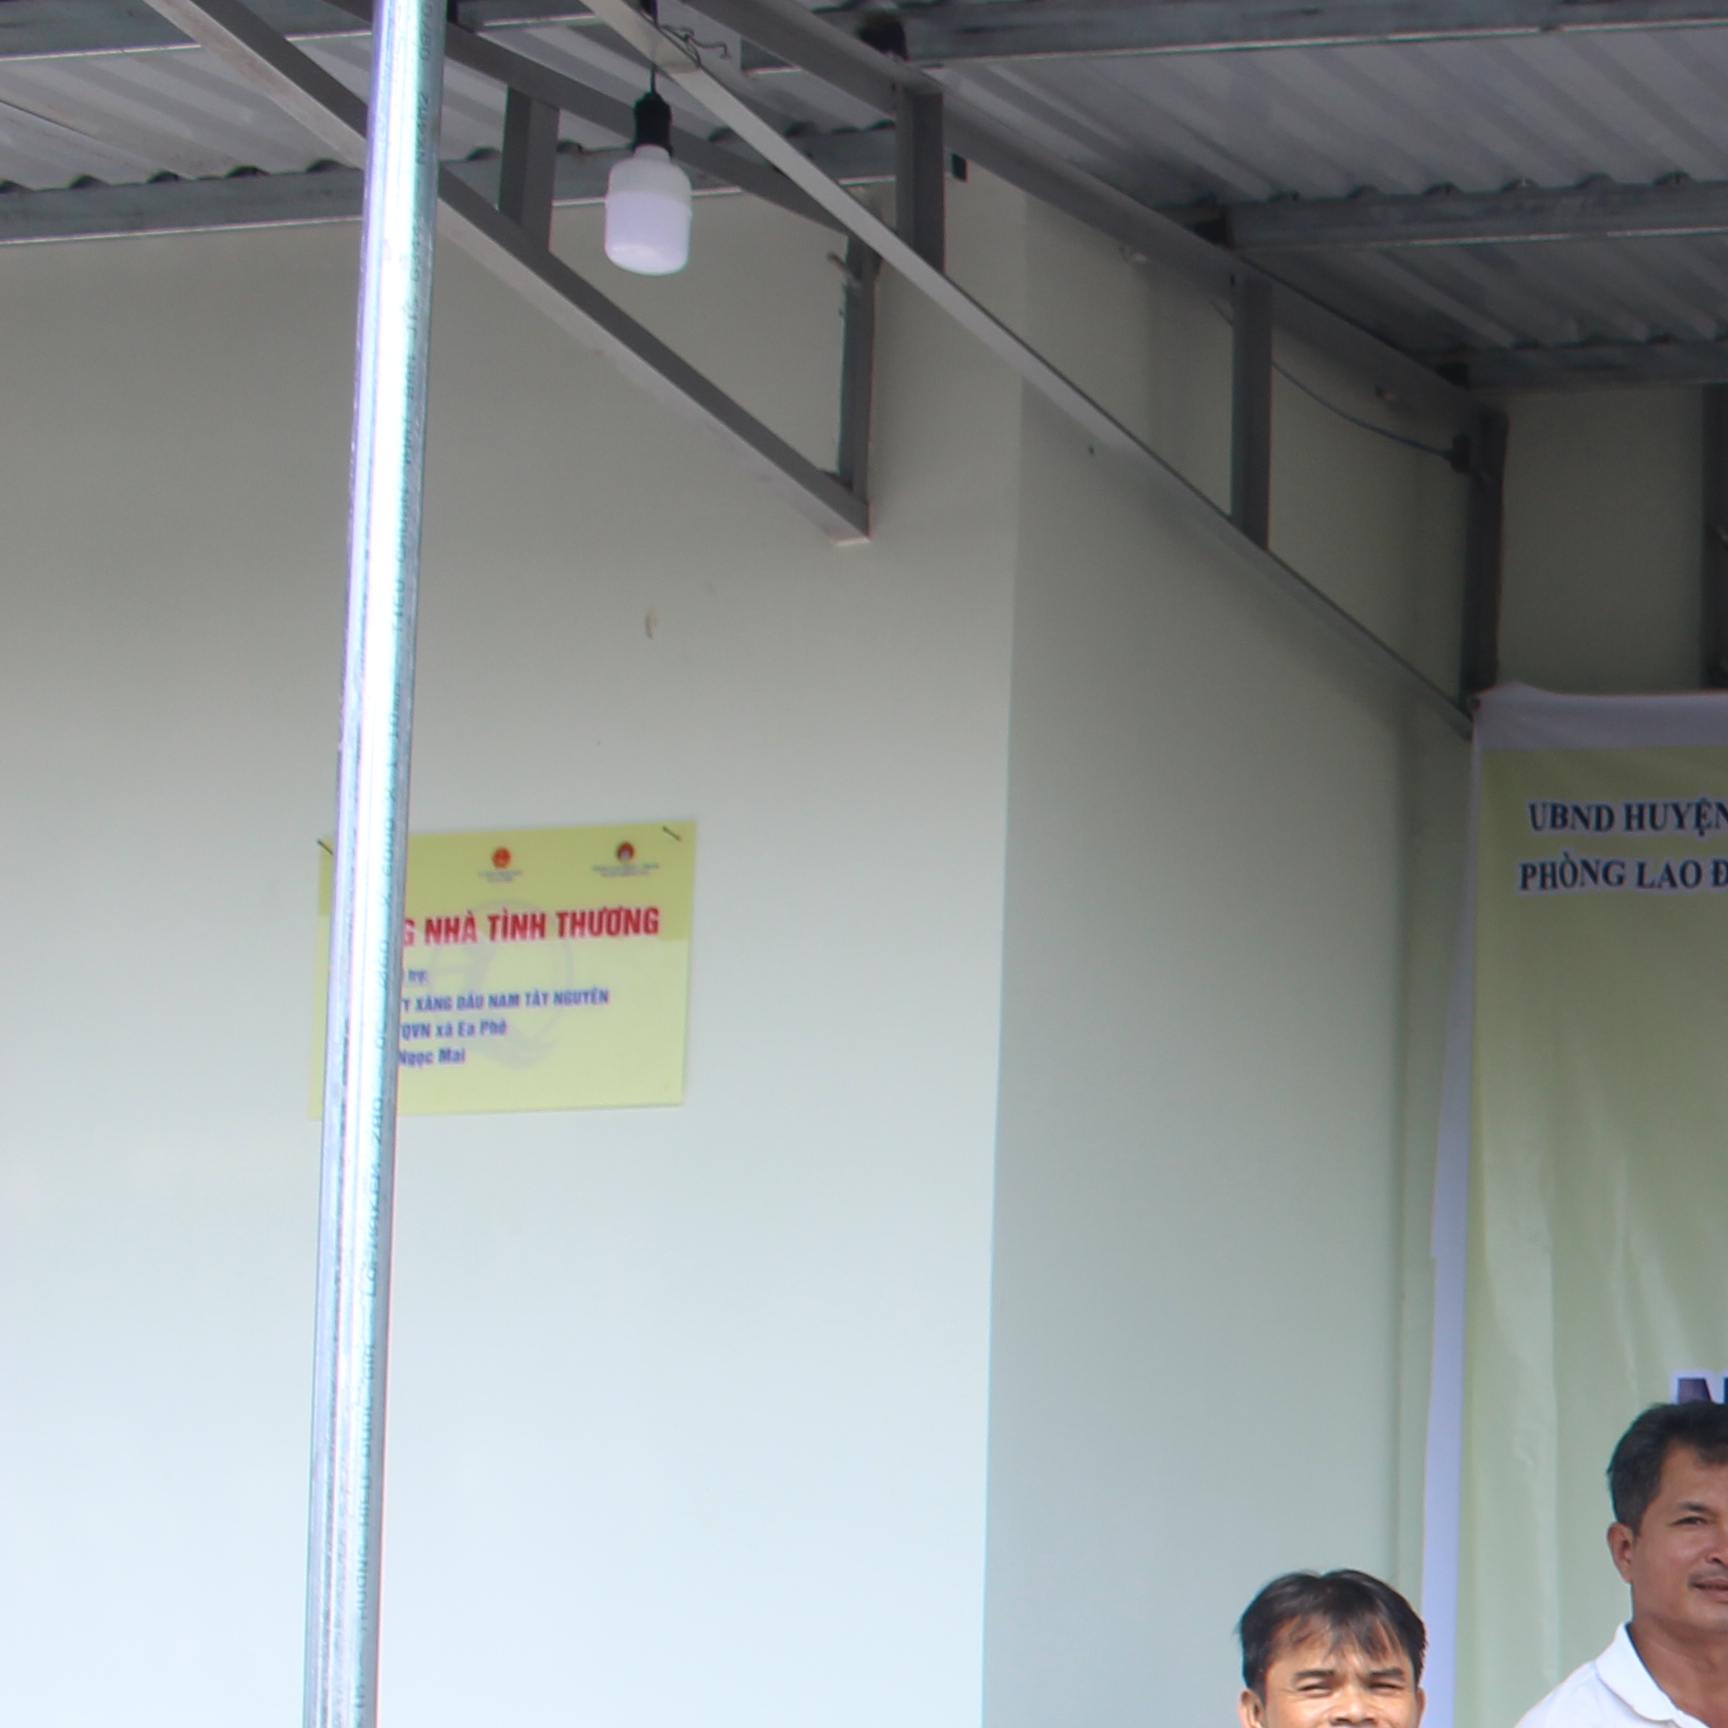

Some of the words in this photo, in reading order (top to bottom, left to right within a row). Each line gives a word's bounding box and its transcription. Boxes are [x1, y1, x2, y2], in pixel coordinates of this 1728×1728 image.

[1529, 801, 1615, 831] UBND
[1519, 852, 1625, 890] PHÒNG
[1636, 859, 1701, 888] LAO
[425, 910, 478, 945] NHÀ
[488, 907, 547, 943] TÌNH
[557, 905, 660, 940] THƯƠNG
